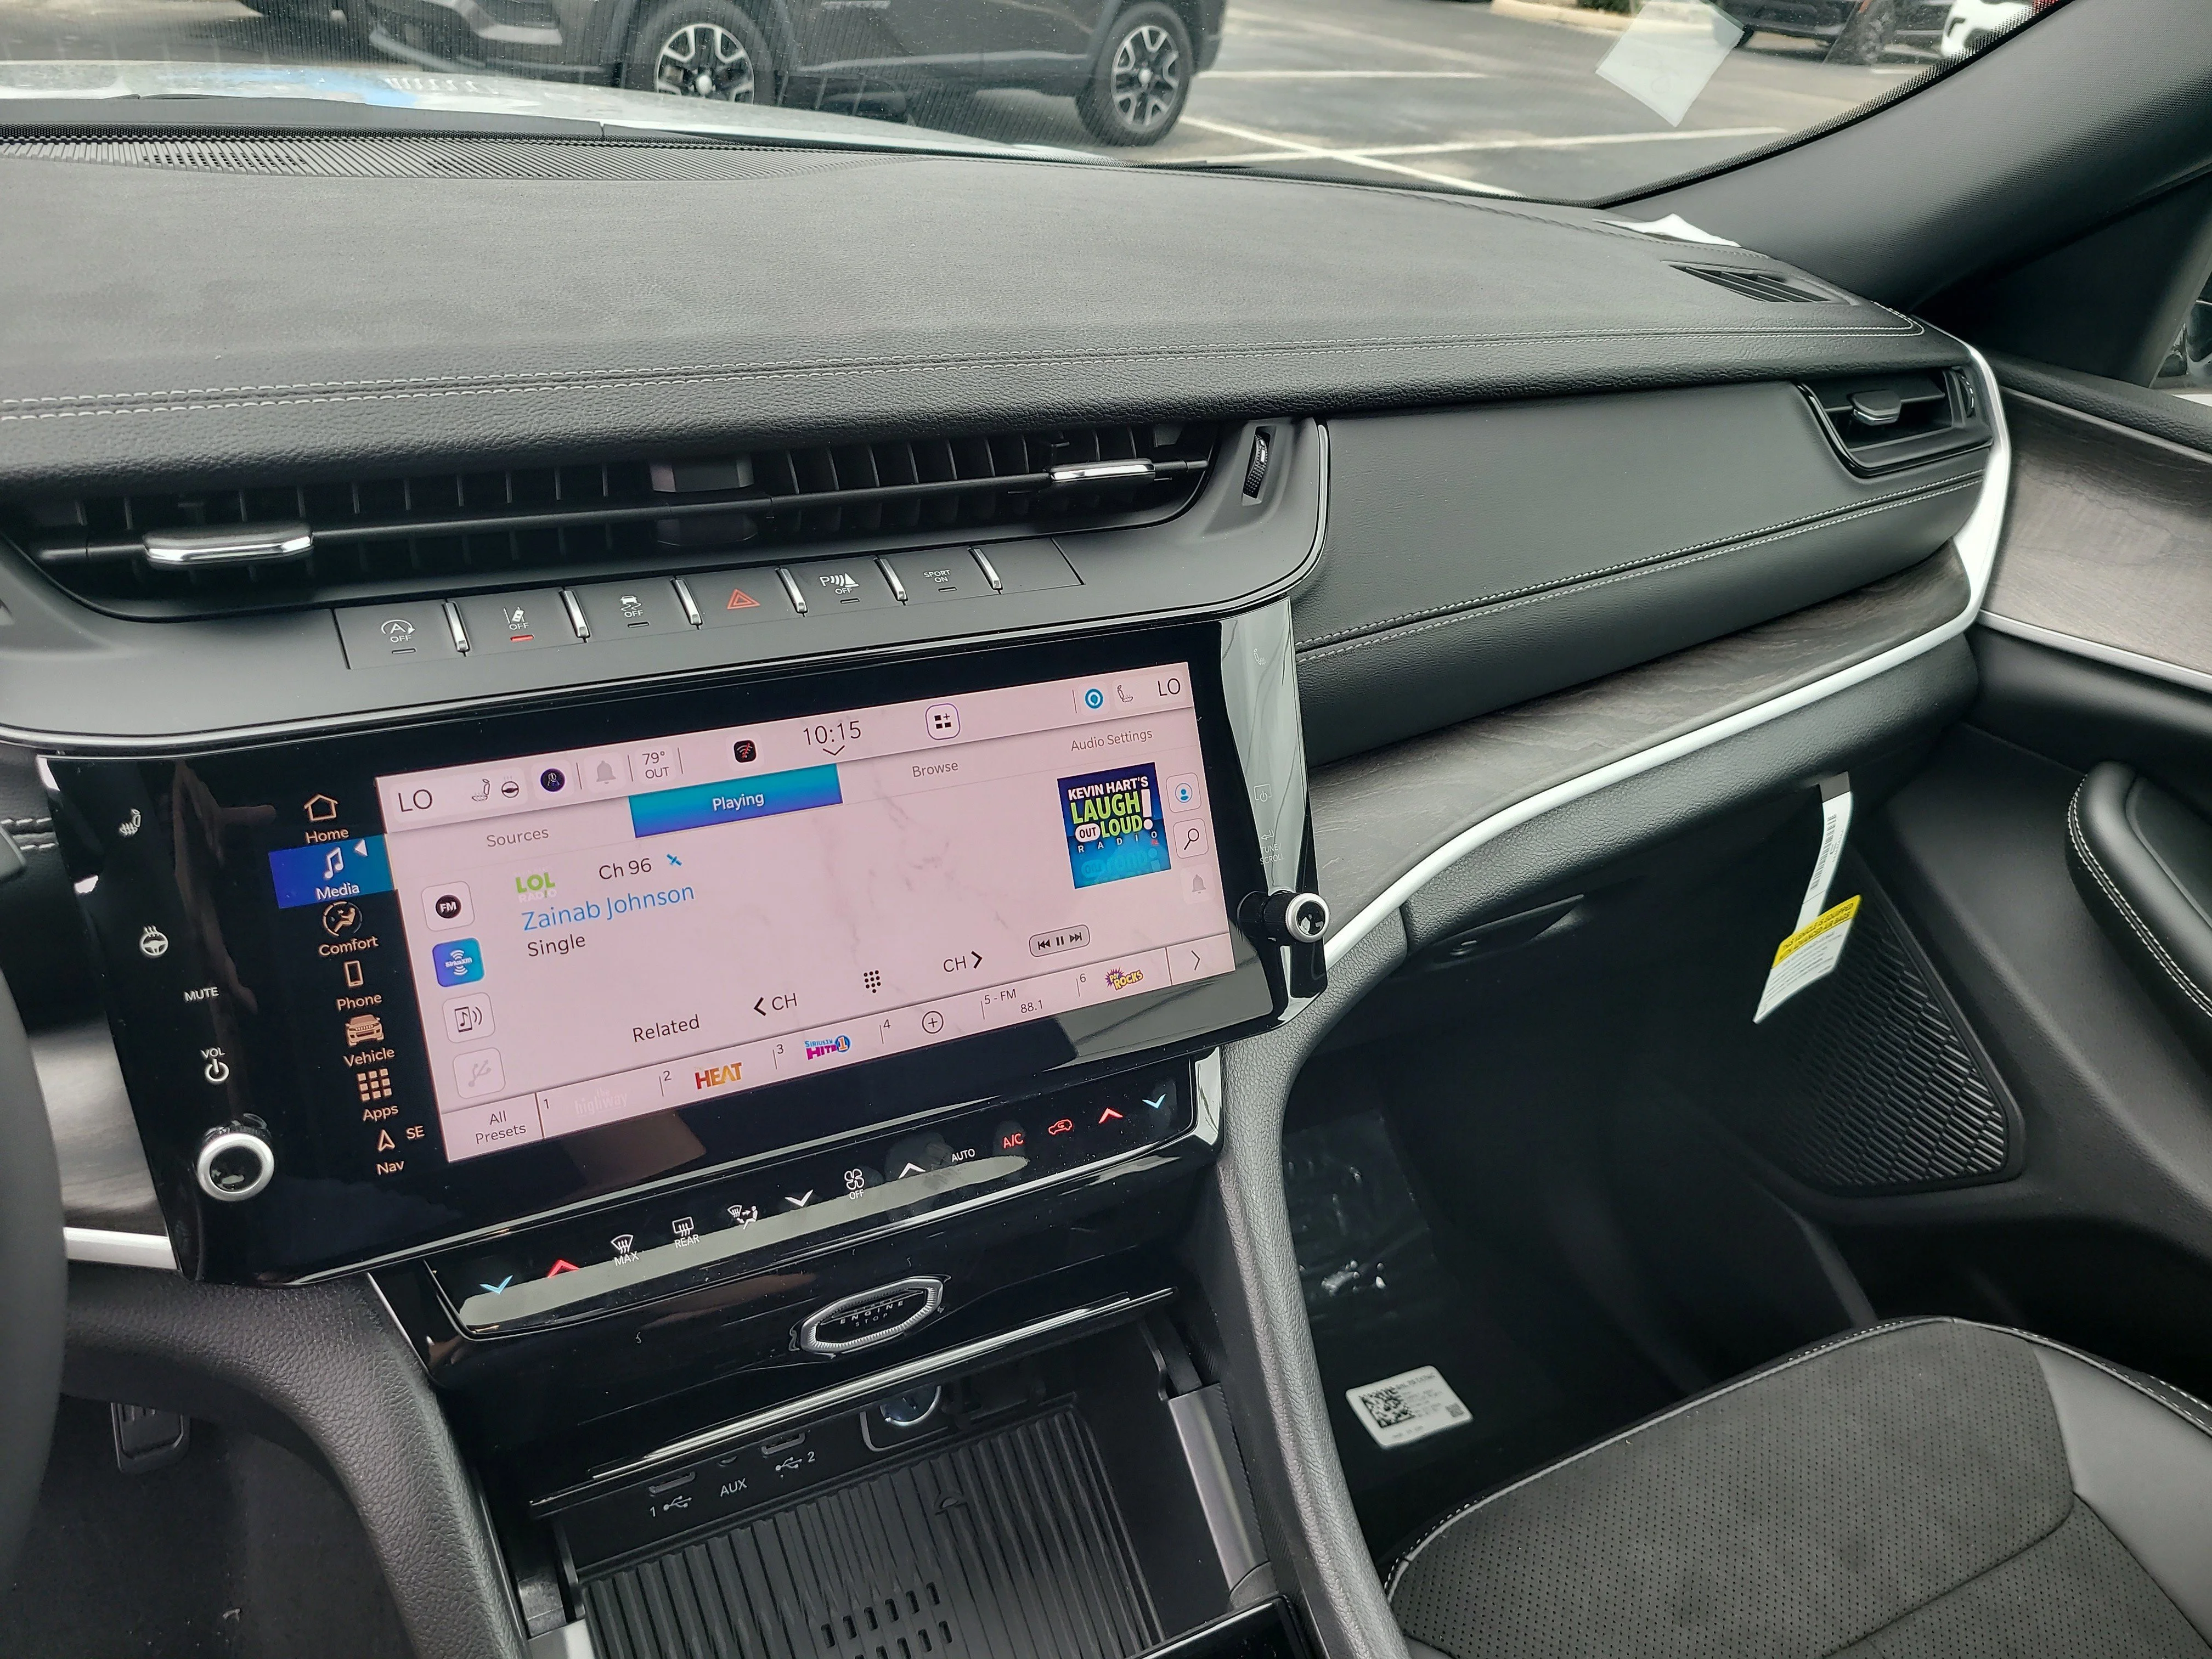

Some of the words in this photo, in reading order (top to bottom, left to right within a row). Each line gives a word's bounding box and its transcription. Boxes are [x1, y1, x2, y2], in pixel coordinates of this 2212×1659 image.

[923, 569, 951, 578] SPORT
[624, 610, 644, 618] OFF
[509, 622, 529, 630] OFF
[390, 635, 411, 643] OFF
[1158, 678, 1181, 697] LO
[803, 720, 862, 746] 10:15
[1071, 737, 1104, 752] Audio
[1107, 729, 1153, 748] Settings
[645, 766, 669, 780] OUT
[912, 760, 959, 778] Browse
[1068, 783, 1104, 801] KEVIN
[1106, 776, 1149, 795] HART'S
[398, 788, 433, 812] LO
[712, 792, 765, 811] Playing
[304, 827, 349, 844] Home
[487, 828, 550, 848] Sources
[1079, 827, 1097, 839] OUT
[1261, 843, 1282, 853] TUNE/
[1260, 855, 1285, 865] SCROLL
[599, 863, 624, 880] Ch
[628, 857, 652, 874] 96
[515, 871, 556, 894] LOL
[316, 882, 360, 901] Media
[440, 901, 457, 913] FM
[521, 900, 601, 932] Zainab
[606, 885, 695, 920] Johnson
[318, 936, 380, 957] Comfort
[527, 933, 587, 957] Single
[943, 956, 967, 973] CH
[1080, 973, 1087, 983] 6
[1114, 969, 1143, 990] ROCKS
[183, 987, 220, 1003] MUTE
[336, 994, 382, 1011] Phone
[771, 992, 798, 1011] CH
[985, 994, 991, 1004] 5
[1000, 989, 1017, 1001] FM
[1020, 1000, 1043, 1014] 88.1
[632, 1013, 701, 1042] Related
[883, 1019, 891, 1029] 4
[201, 1047, 225, 1059] VOL
[342, 1047, 396, 1067] Vehicle
[776, 1045, 785, 1054] 3
[663, 1070, 672, 1082] 2
[695, 1062, 743, 1090] HEAT
[543, 1098, 550, 1110] 1
[363, 1105, 399, 1122] Apps
[489, 1110, 507, 1125] All
[407, 1125, 425, 1139] SE
[475, 1124, 527, 1144] Presets
[1002, 1133, 1024, 1149] A/C
[951, 1148, 975, 1163] AUTO
[376, 1160, 405, 1175] Nav
[849, 1189, 865, 1200] OFF
[674, 1234, 700, 1249] REAR
[613, 1251, 640, 1267] MAX
[840, 1300, 904, 1325] ENGINE
[855, 1312, 888, 1327] STOP
[808, 1451, 816, 1463] 2
[720, 1477, 748, 1497] AUX
[650, 1506, 656, 1517] 1
